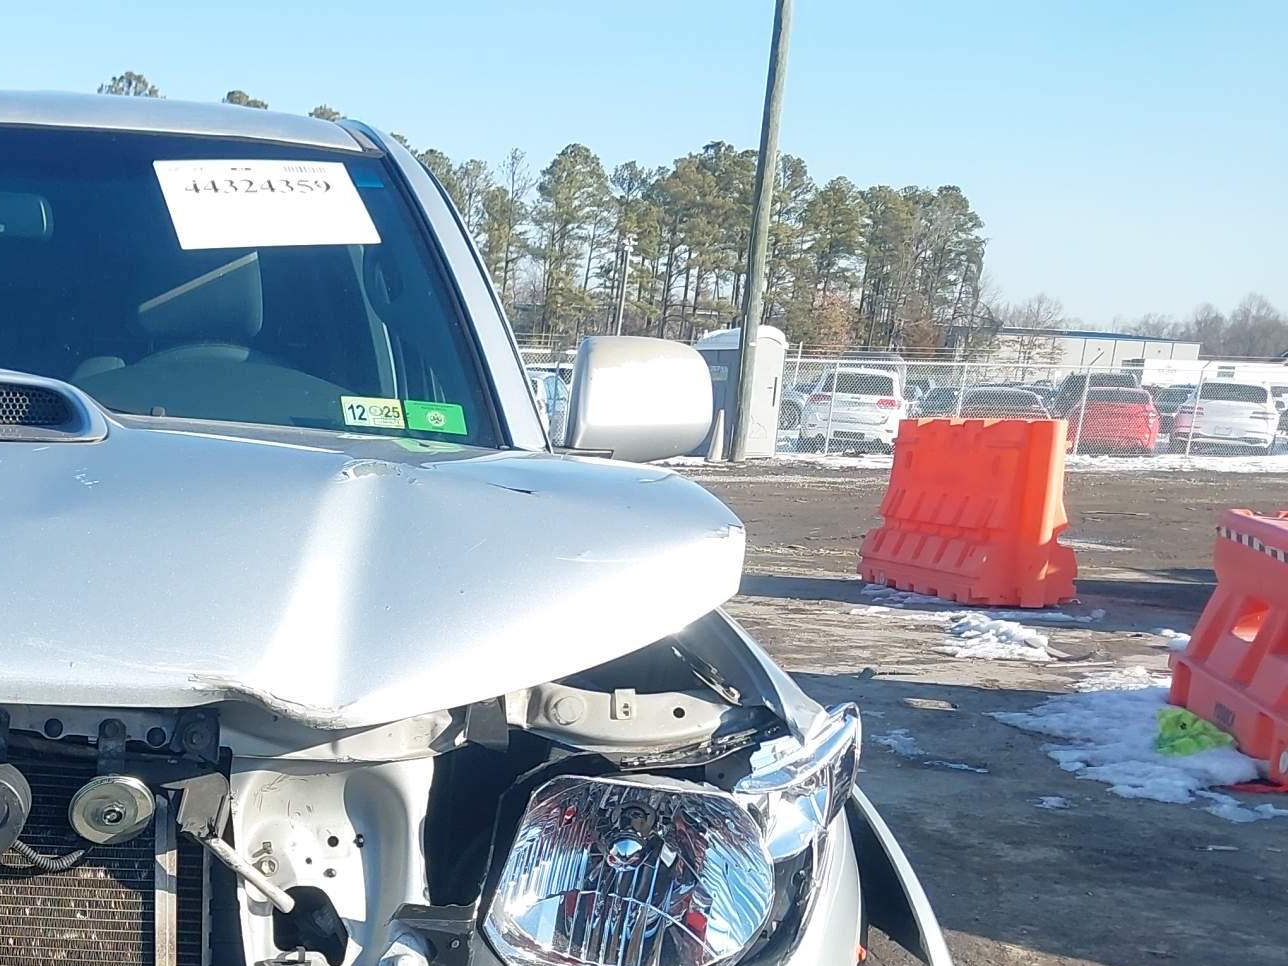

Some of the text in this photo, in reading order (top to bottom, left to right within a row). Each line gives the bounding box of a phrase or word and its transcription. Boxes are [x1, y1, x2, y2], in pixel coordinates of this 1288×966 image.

[184, 179, 331, 194] 44324359
[347, 404, 368, 421] 12
[383, 405, 401, 419] 25
